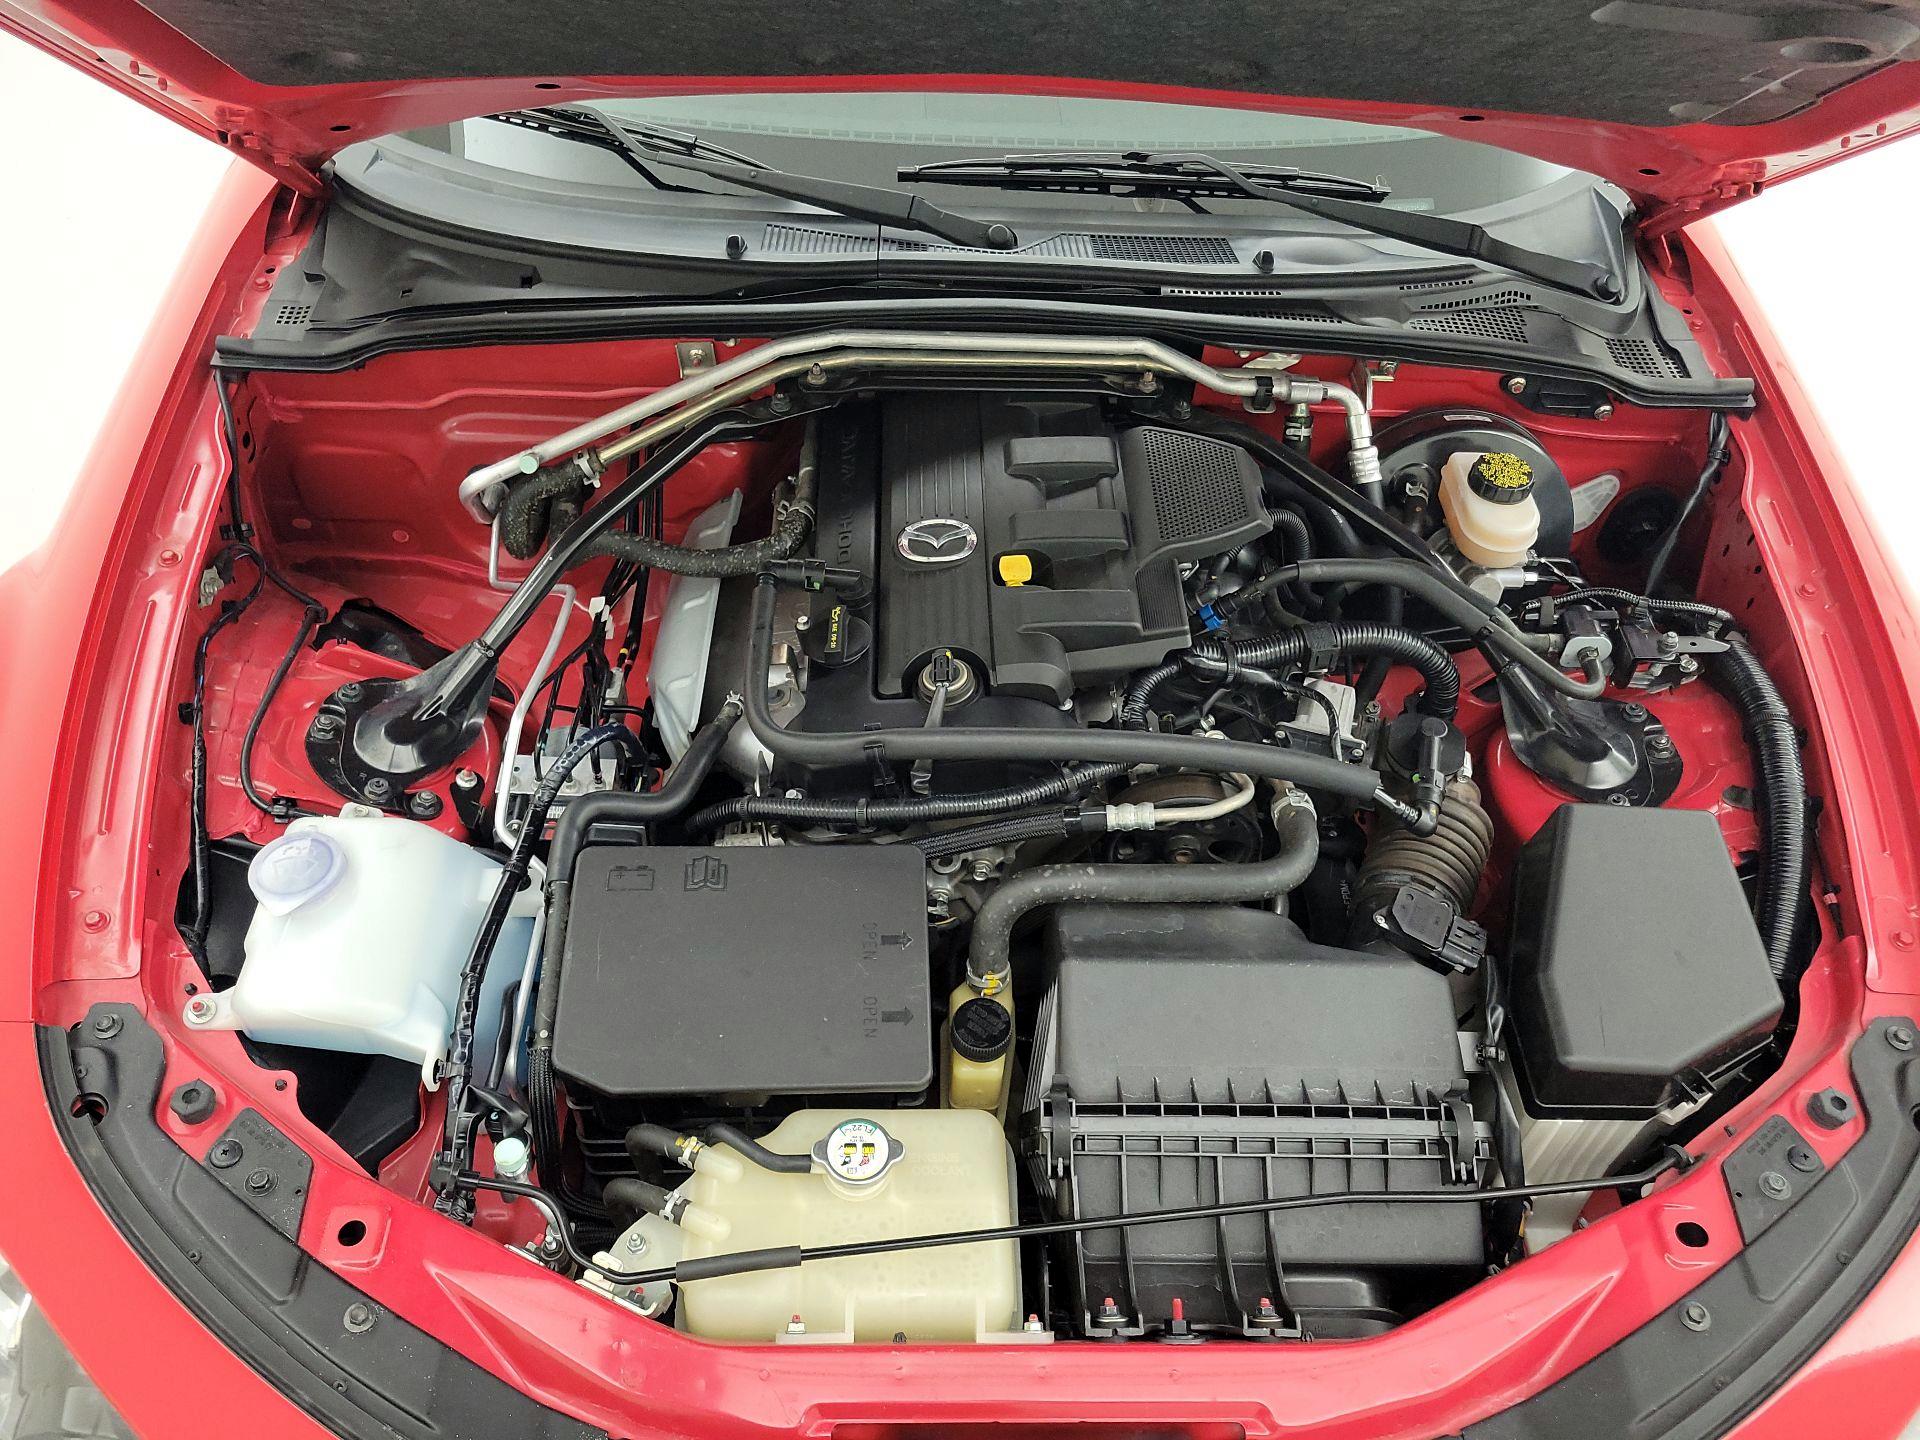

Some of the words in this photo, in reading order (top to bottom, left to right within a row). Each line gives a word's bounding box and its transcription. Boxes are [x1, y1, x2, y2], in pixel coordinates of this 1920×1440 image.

[862, 922, 878, 960] OPEN
[862, 996, 878, 1038] OPEN
[911, 1152, 960, 1162] ENGINE
[912, 1166, 971, 1177] COOLANT
